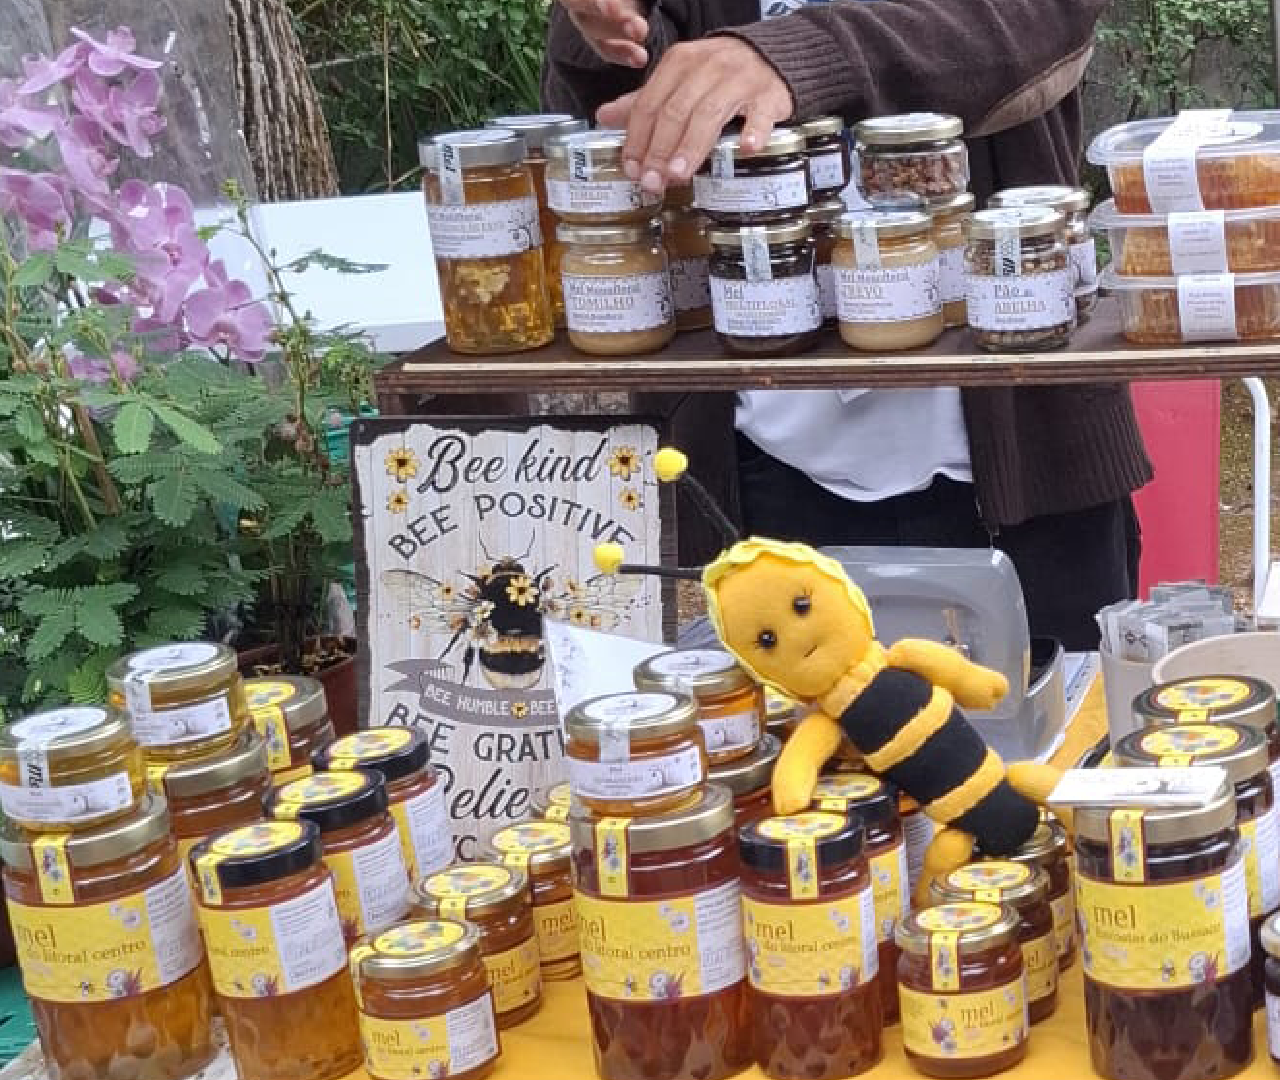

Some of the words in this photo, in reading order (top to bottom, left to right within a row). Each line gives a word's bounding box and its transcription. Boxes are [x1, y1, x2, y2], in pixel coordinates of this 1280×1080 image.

[416, 434, 508, 494] Bee
[513, 437, 609, 484] kind
[388, 503, 459, 561] BEE
[424, 683, 452, 706] BEE
[456, 695, 509, 716] HUMBLE
[530, 700, 556, 716] BEE
[1092, 904, 1136, 929] mel
[755, 919, 795, 941] mel
[91, 938, 147, 962] centro
[638, 943, 691, 961] centro
